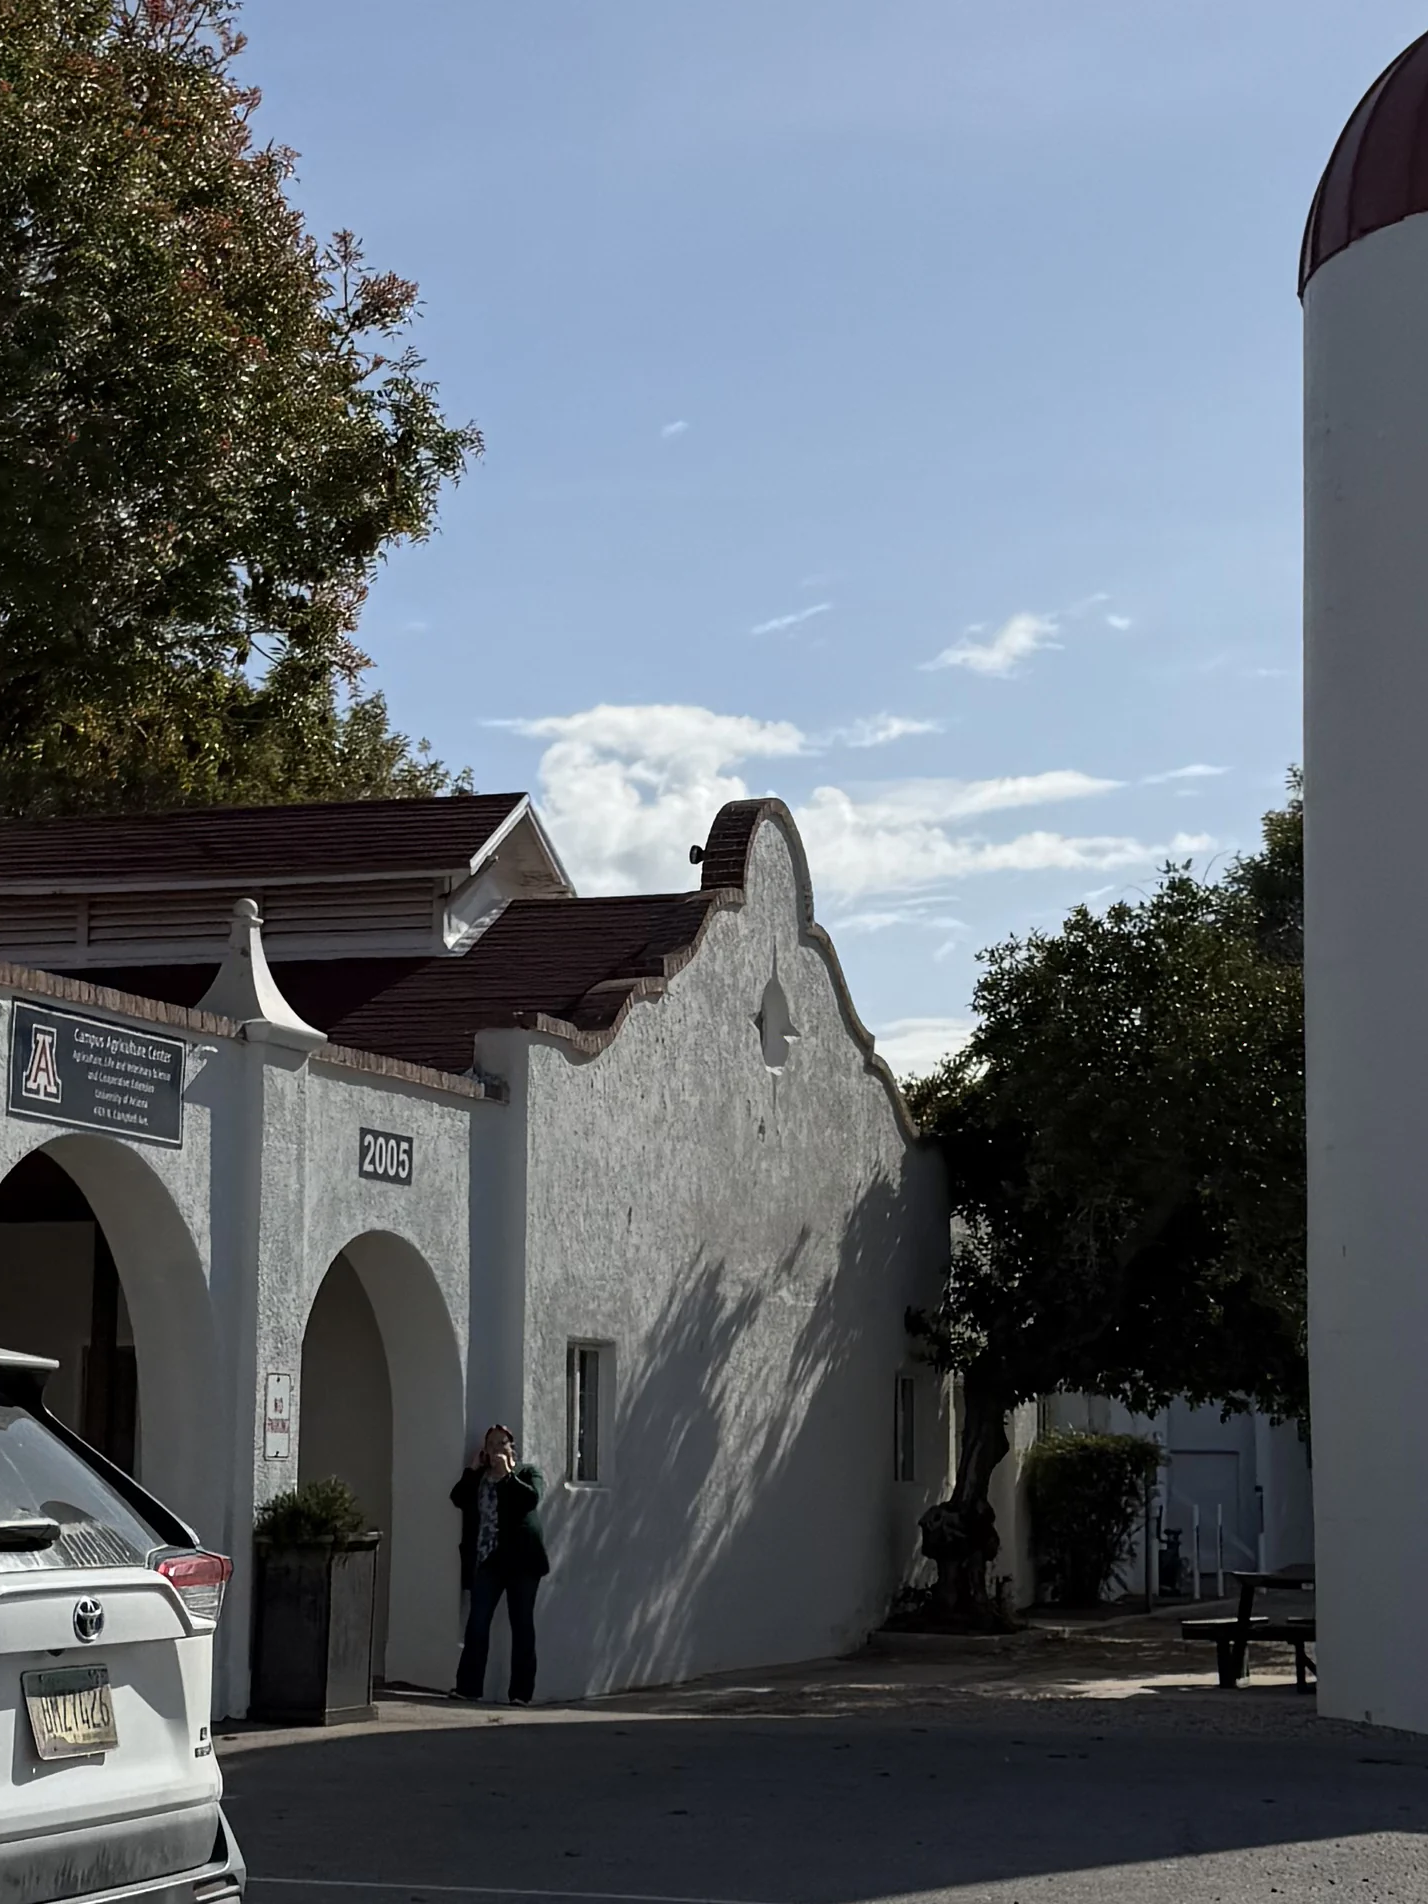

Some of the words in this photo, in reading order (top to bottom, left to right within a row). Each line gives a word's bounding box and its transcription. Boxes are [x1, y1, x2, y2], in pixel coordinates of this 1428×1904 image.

[74, 1028, 104, 1048] Campus
[106, 1036, 146, 1058] Agriculture
[148, 1046, 171, 1063] Center
[363, 1134, 409, 1178] 2005
